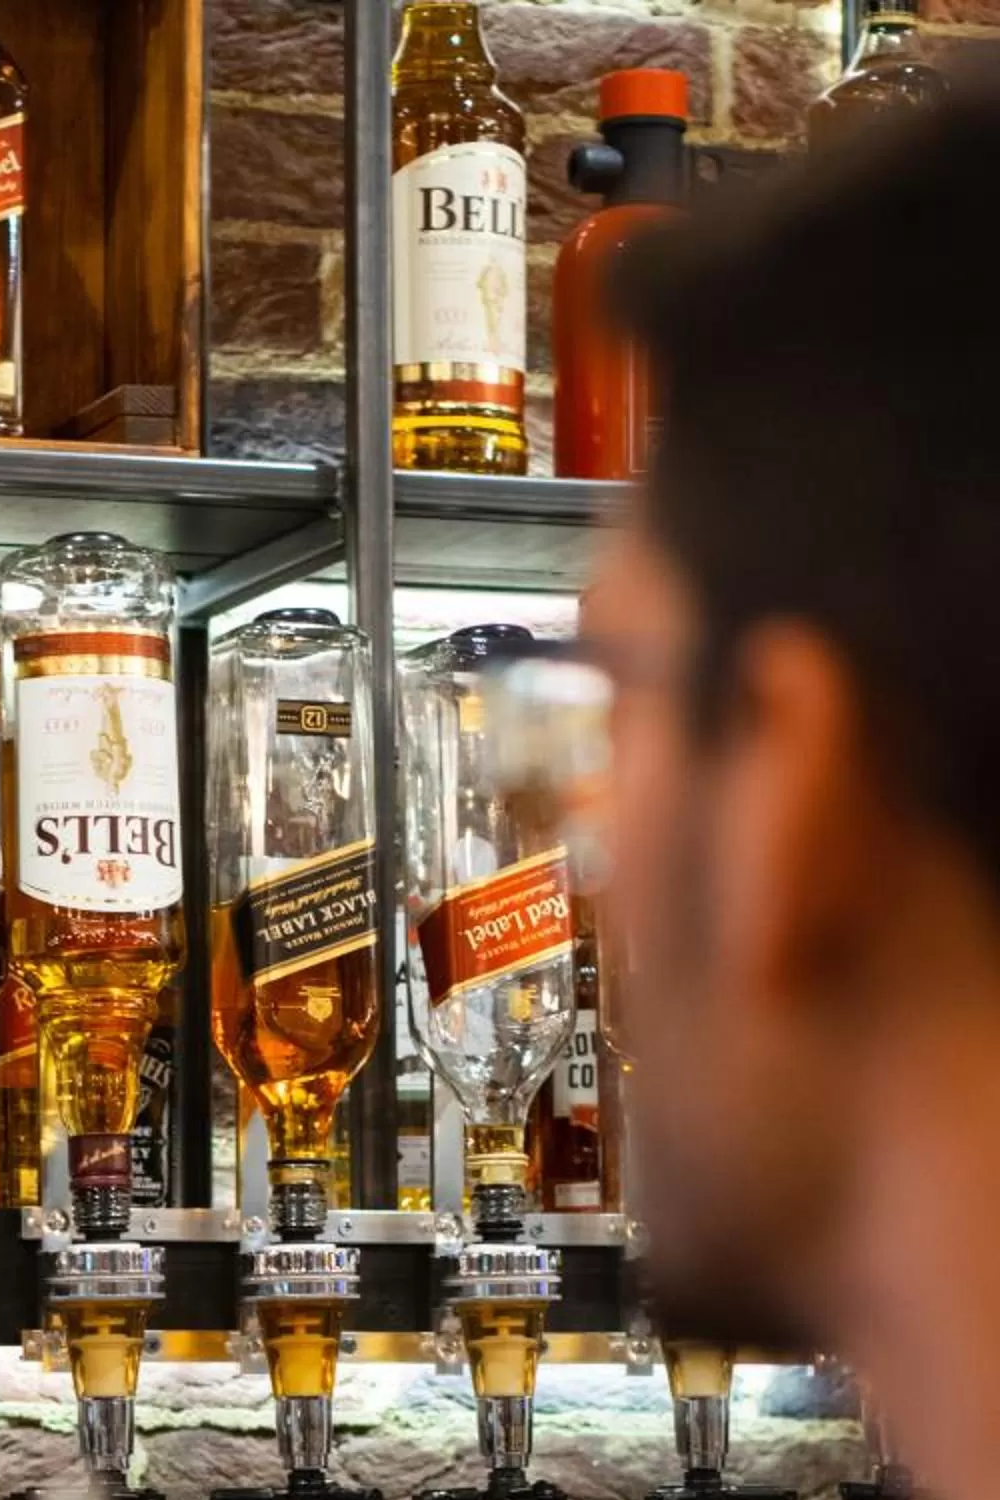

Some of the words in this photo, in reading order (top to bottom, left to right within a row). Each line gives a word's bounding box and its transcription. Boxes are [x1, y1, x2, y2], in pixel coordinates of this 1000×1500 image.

[417, 186, 524, 241] BELL
[305, 711, 321, 727] 12
[35, 815, 177, 868] BELL'S
[318, 889, 377, 923] BLACK
[525, 893, 569, 928] Red
[256, 911, 318, 943] LABEL
[463, 909, 526, 952] Label
